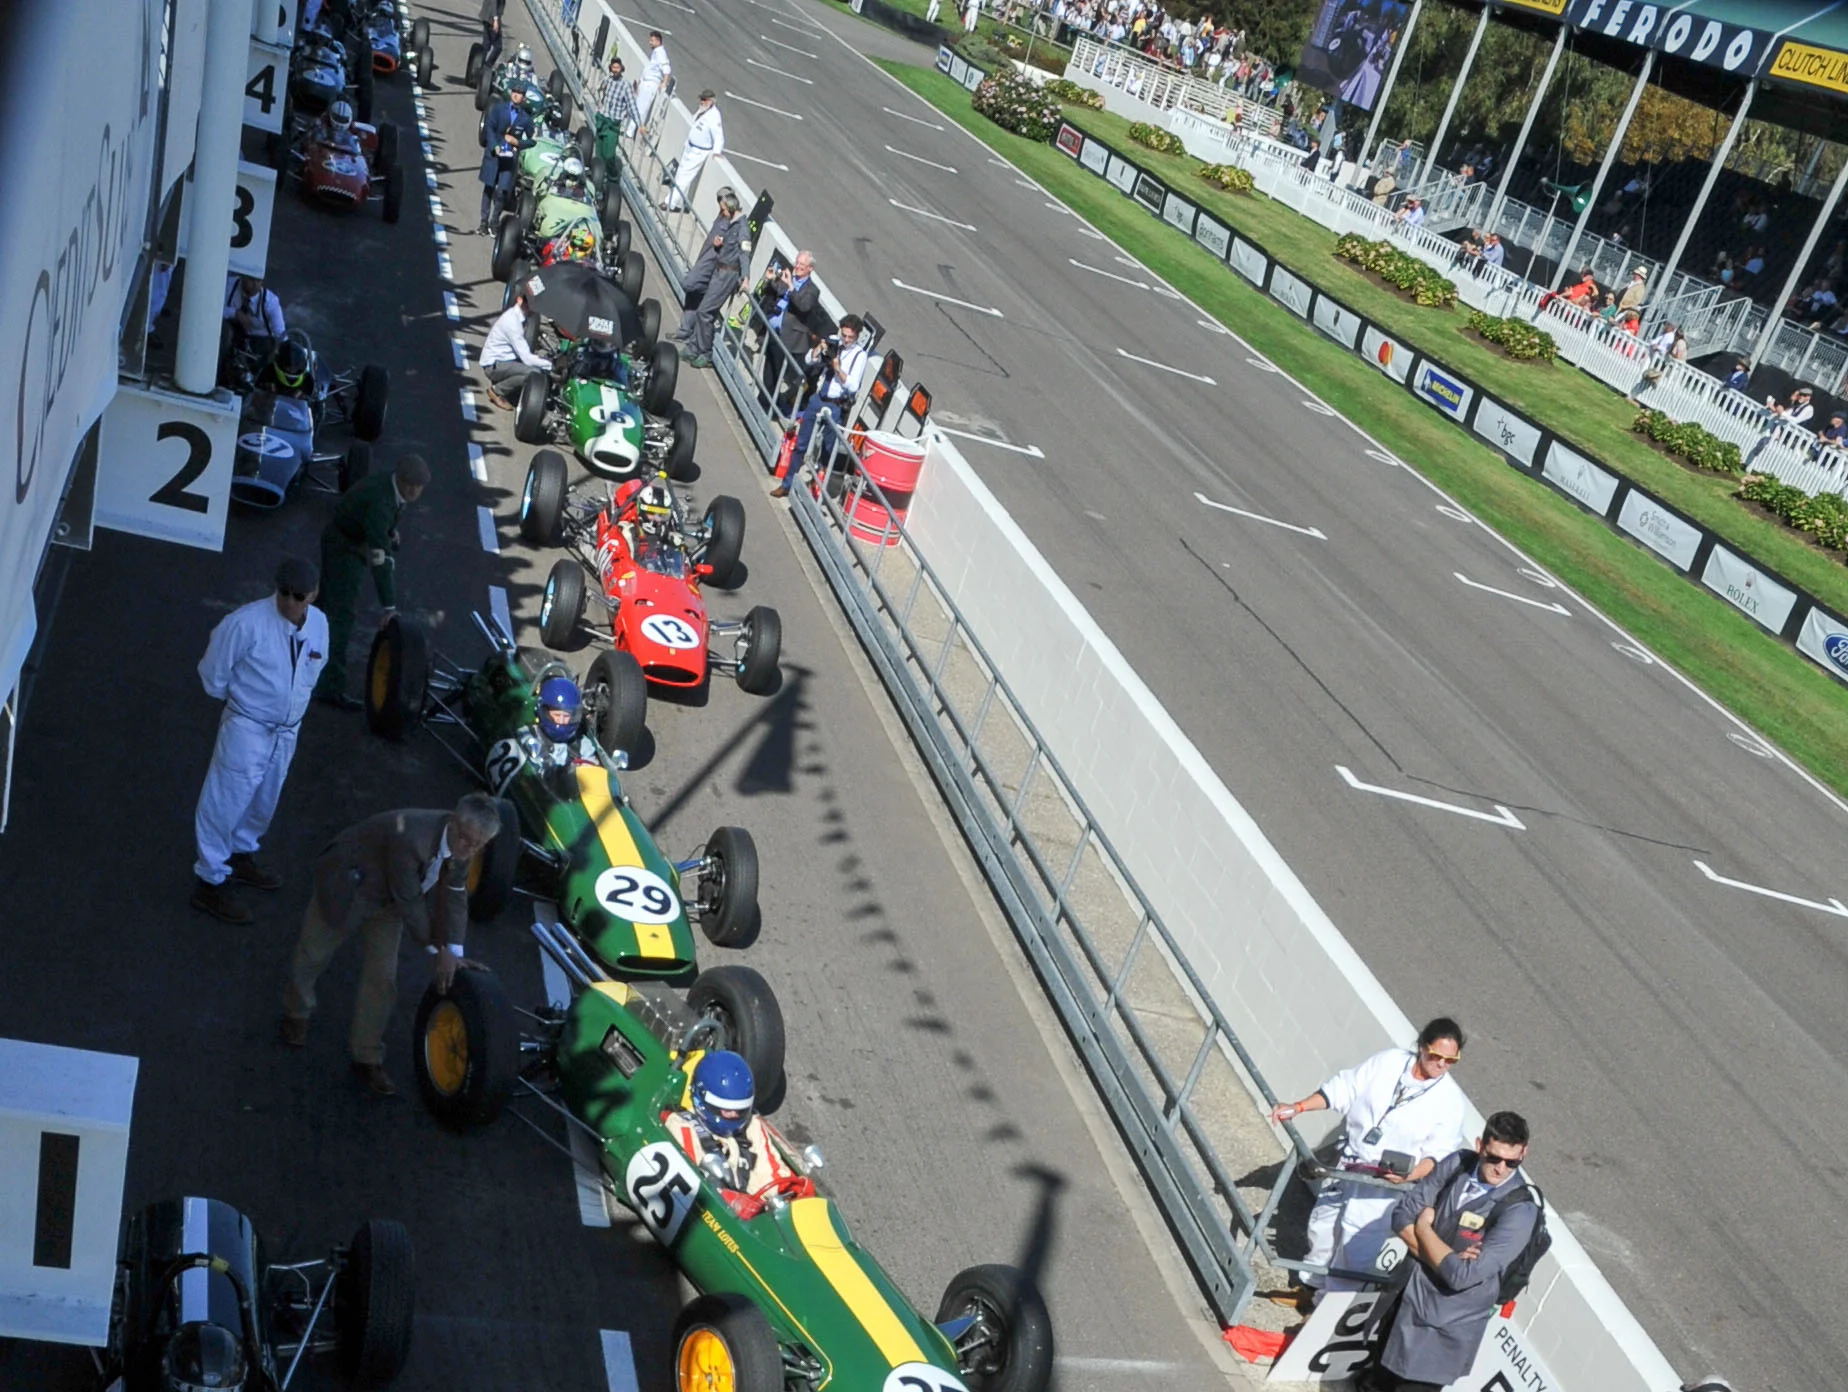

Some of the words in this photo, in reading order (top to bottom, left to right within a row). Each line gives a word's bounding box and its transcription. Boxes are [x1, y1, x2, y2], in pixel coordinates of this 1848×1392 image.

[1580, 0, 1753, 71] FERODO
[1778, 48, 1831, 78] CLUTCH
[245, 65, 276, 114] 4
[230, 185, 255, 248] 3
[149, 421, 212, 514] 2
[1726, 584, 1760, 615] ROLEX
[649, 620, 693, 644] 13
[605, 875, 672, 915] 29
[33, 1131, 80, 1269] 1
[632, 1151, 692, 1229] 25
